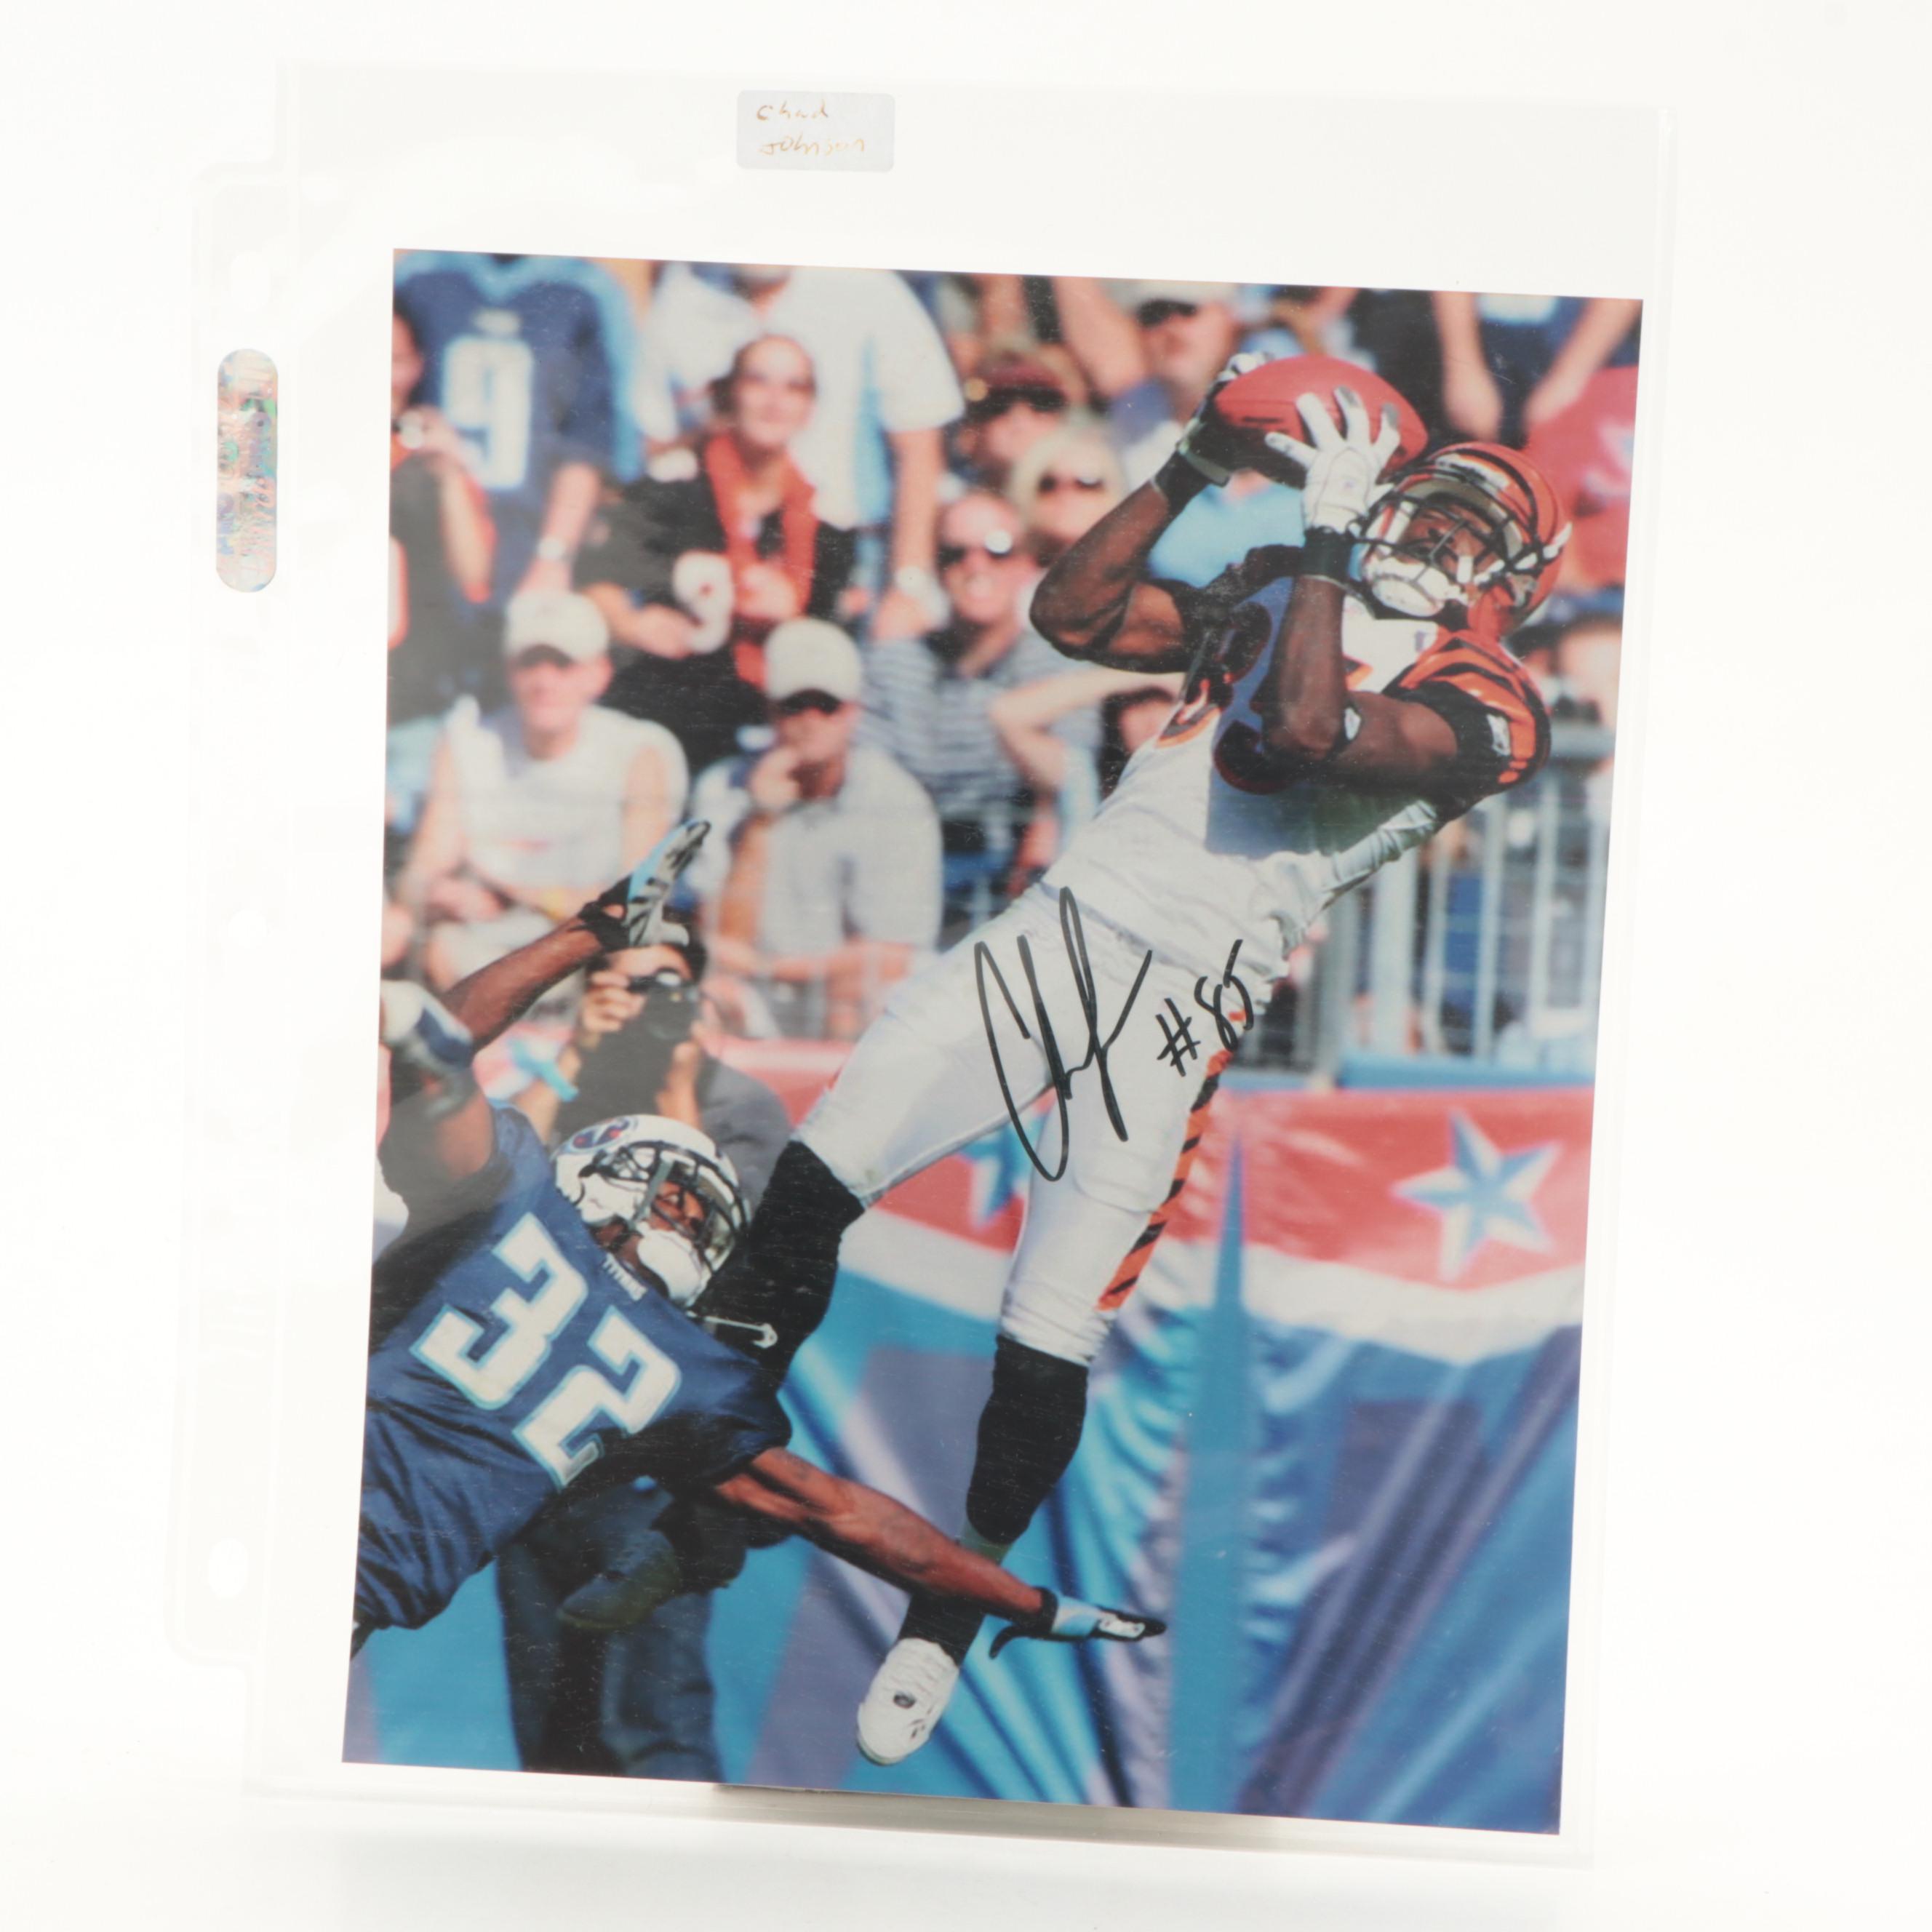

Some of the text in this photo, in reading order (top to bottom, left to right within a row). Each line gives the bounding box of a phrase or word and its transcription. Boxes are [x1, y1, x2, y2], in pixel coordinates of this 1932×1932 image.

[756, 99, 829, 121] Chad
[441, 337, 533, 488] 9
[1155, 938, 1254, 1077] #85
[409, 1211, 682, 1493] 32
